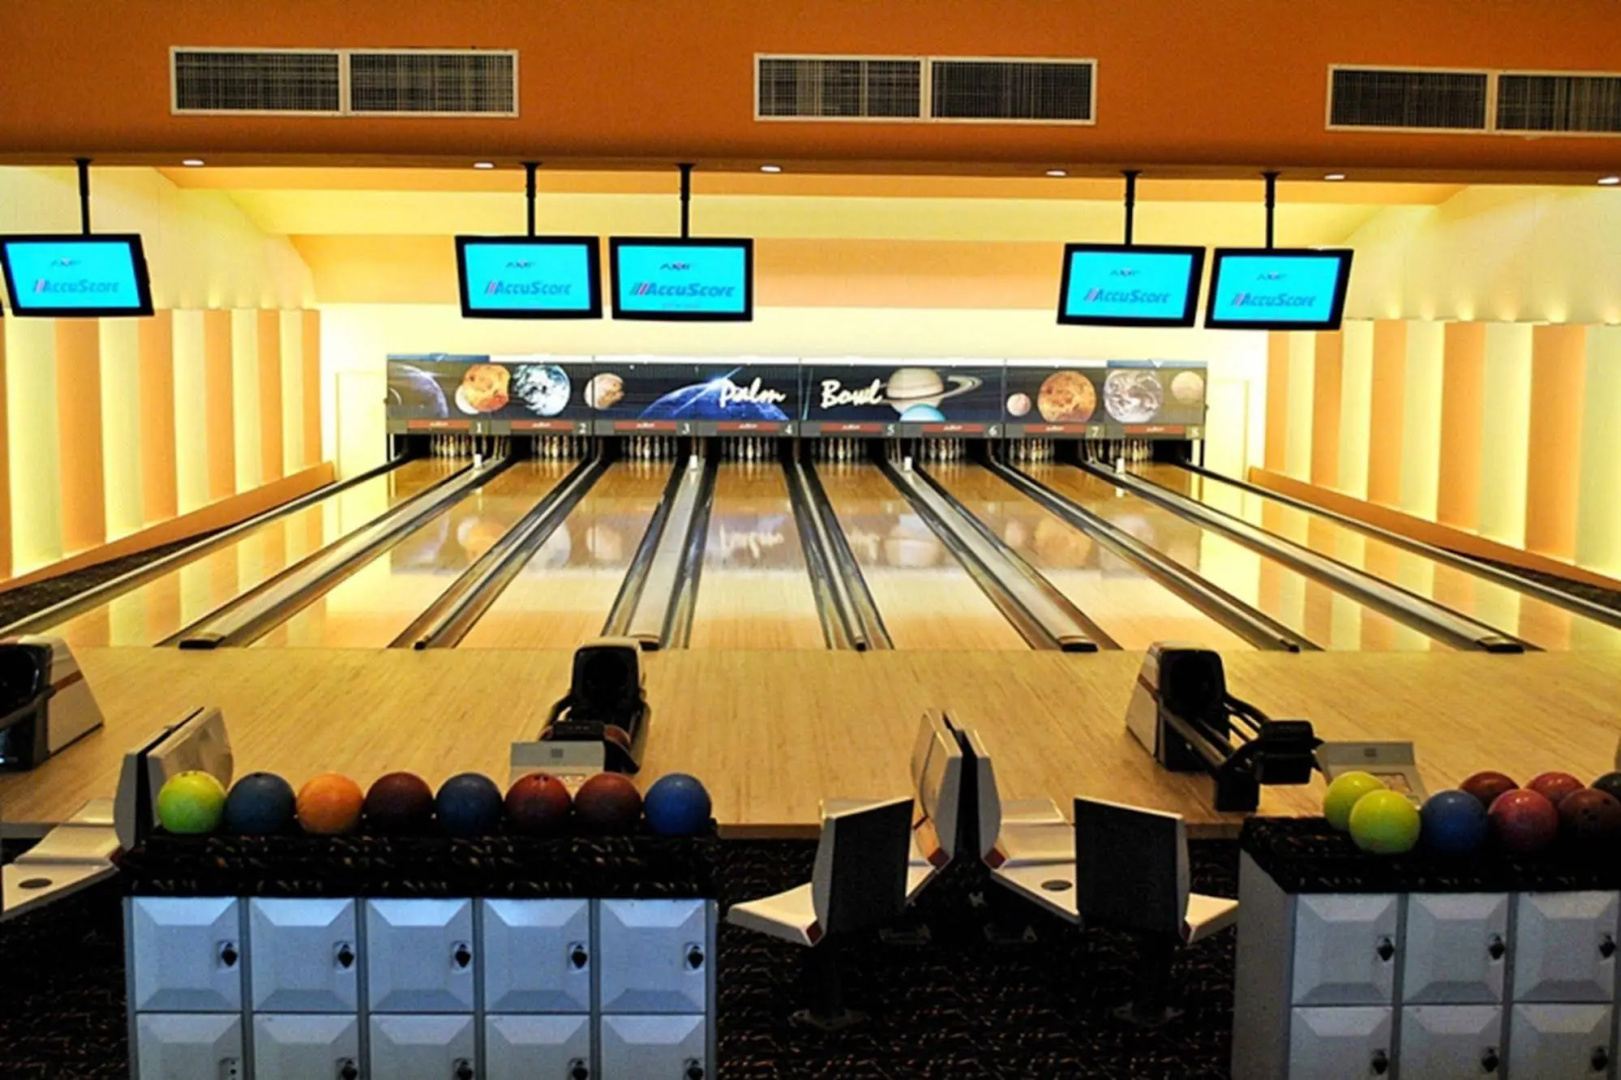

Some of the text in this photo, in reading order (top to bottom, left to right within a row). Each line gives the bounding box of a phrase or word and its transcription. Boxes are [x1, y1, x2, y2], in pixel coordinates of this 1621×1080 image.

[719, 377, 883, 409] Palm Bowl
[475, 422, 482, 433] 1
[578, 423, 587, 434] 2
[682, 423, 690, 435] 3
[784, 424, 793, 435] 4
[886, 424, 895, 436] 5
[988, 426, 998, 437] 6
[1091, 426, 1100, 438] 7
